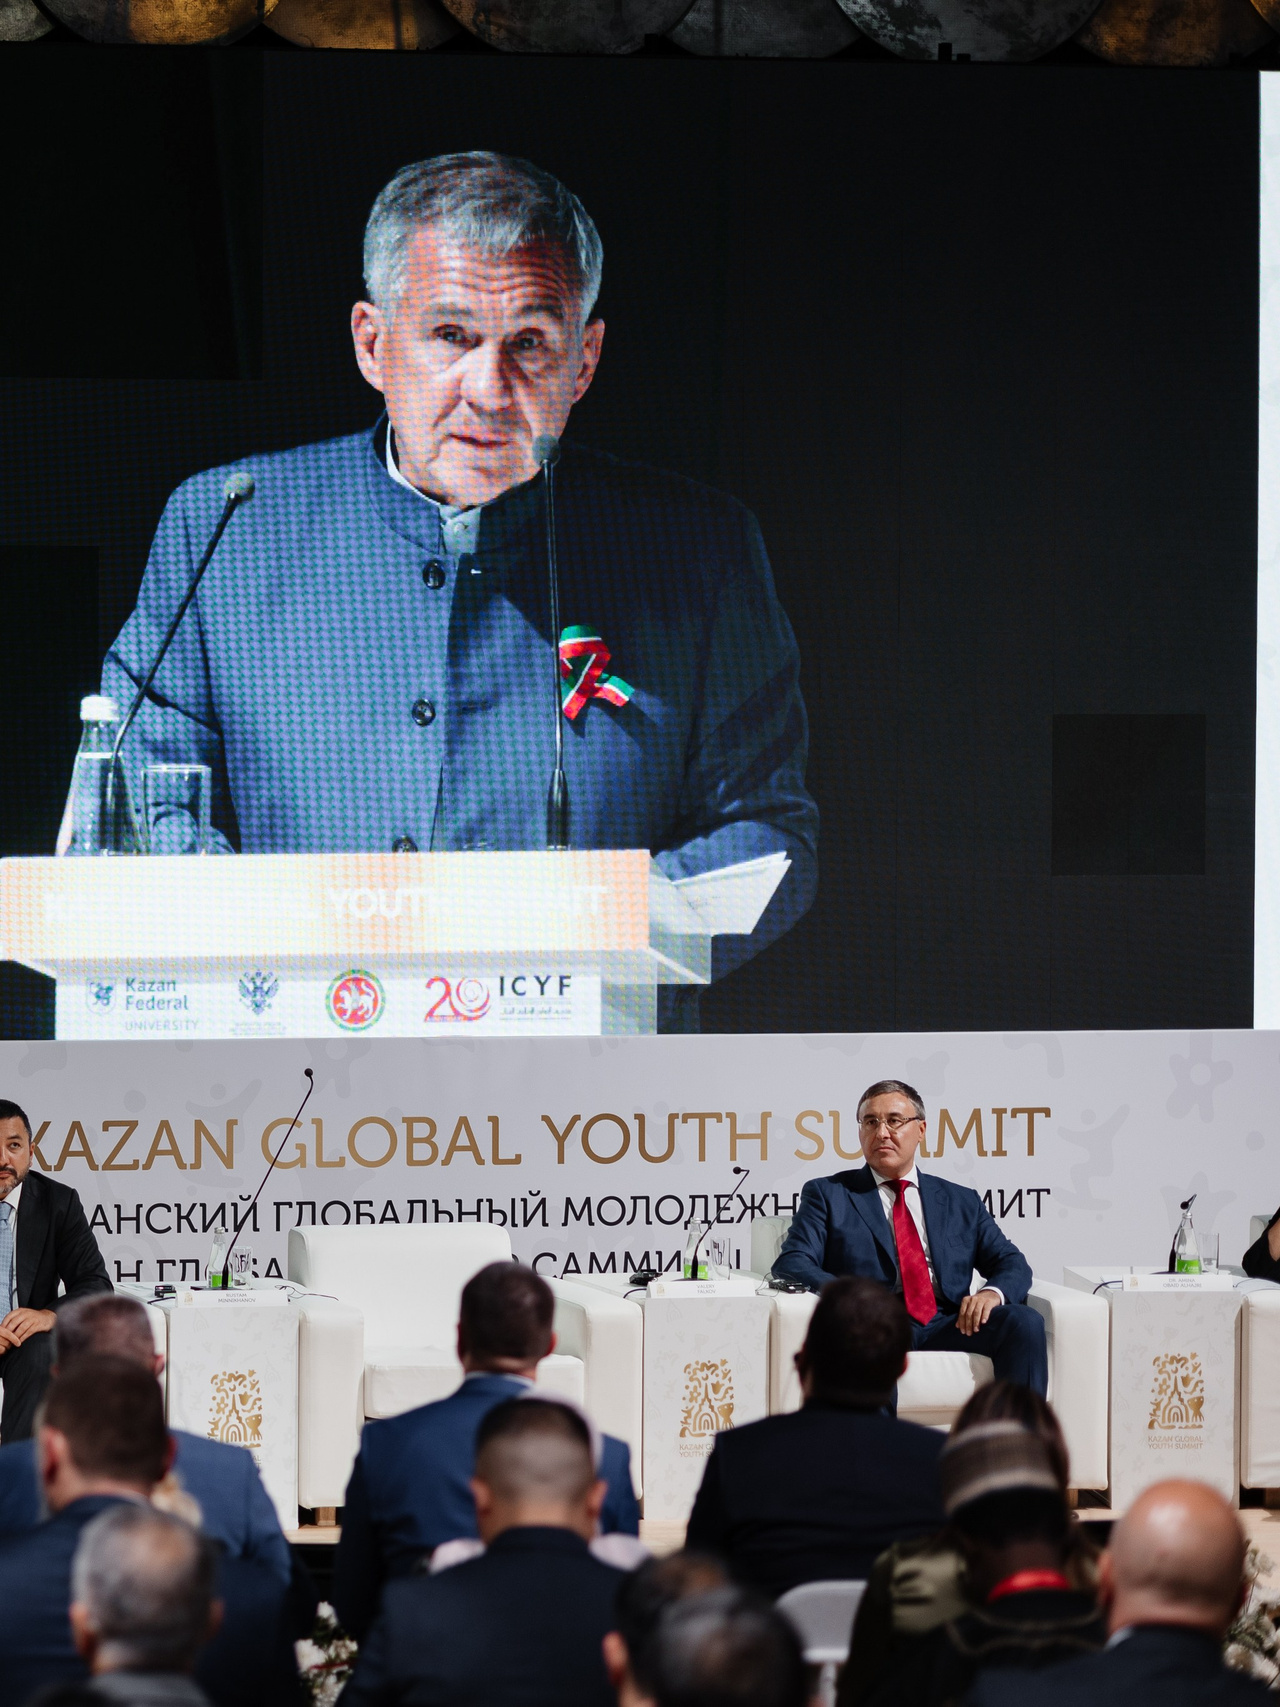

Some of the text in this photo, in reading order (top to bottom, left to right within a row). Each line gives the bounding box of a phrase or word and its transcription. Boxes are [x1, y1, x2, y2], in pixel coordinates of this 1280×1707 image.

[125, 977, 177, 992] Kazan
[499, 975, 572, 997] ICYF
[125, 995, 188, 1011] Federal
[125, 1020, 200, 1032] UNIVERSITY
[261, 1115, 522, 1170] GLOBAL
[541, 1111, 773, 1165] YOUTH
[794, 1106, 1051, 1161] SUMIT
[89, 1194, 260, 1235] АНСКИЙ
[273, 1190, 547, 1232] ГЛОБАЛЬНЫЙ
[562, 1193, 799, 1230] МОЛОДЕЖН
